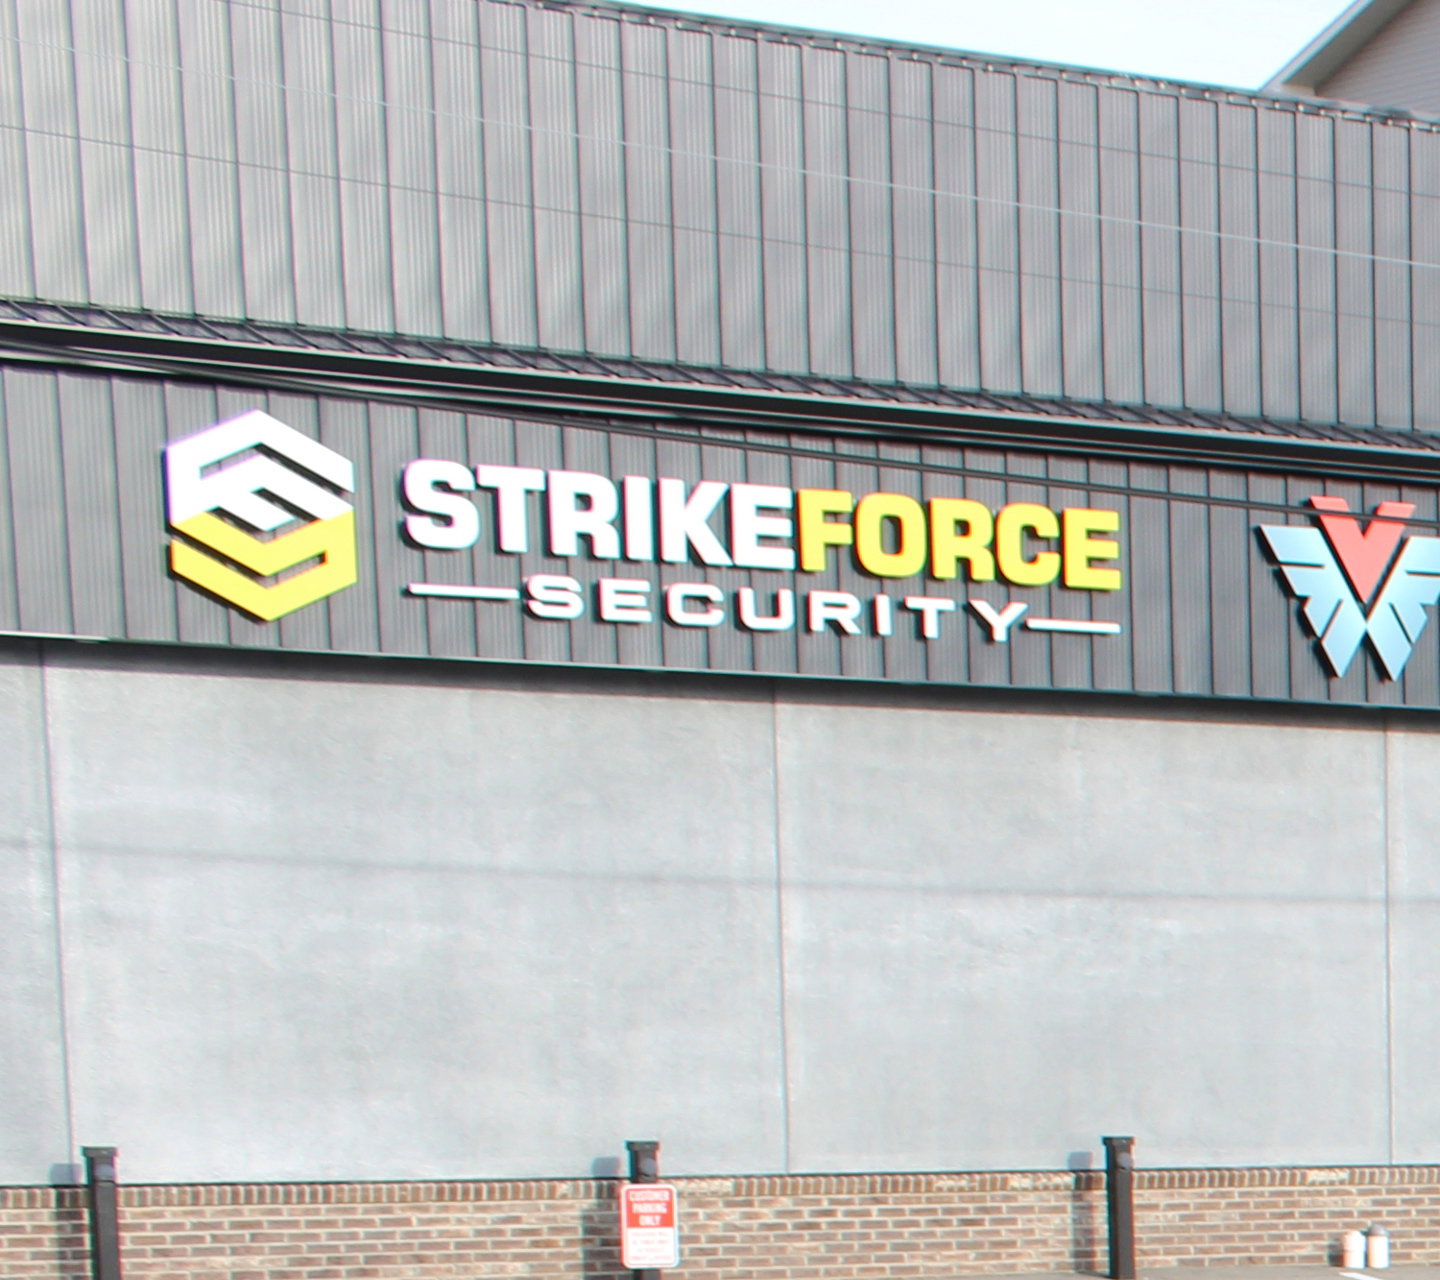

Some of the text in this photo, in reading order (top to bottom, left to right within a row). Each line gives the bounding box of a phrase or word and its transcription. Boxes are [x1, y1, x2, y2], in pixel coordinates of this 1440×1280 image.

[403, 458, 1123, 591] STRIKEFORCE
[526, 574, 1030, 642] SECURITY
[629, 1190, 670, 1201] CUSTOMER
[632, 1202, 668, 1214] PARKING
[638, 1214, 662, 1226] ONLY
